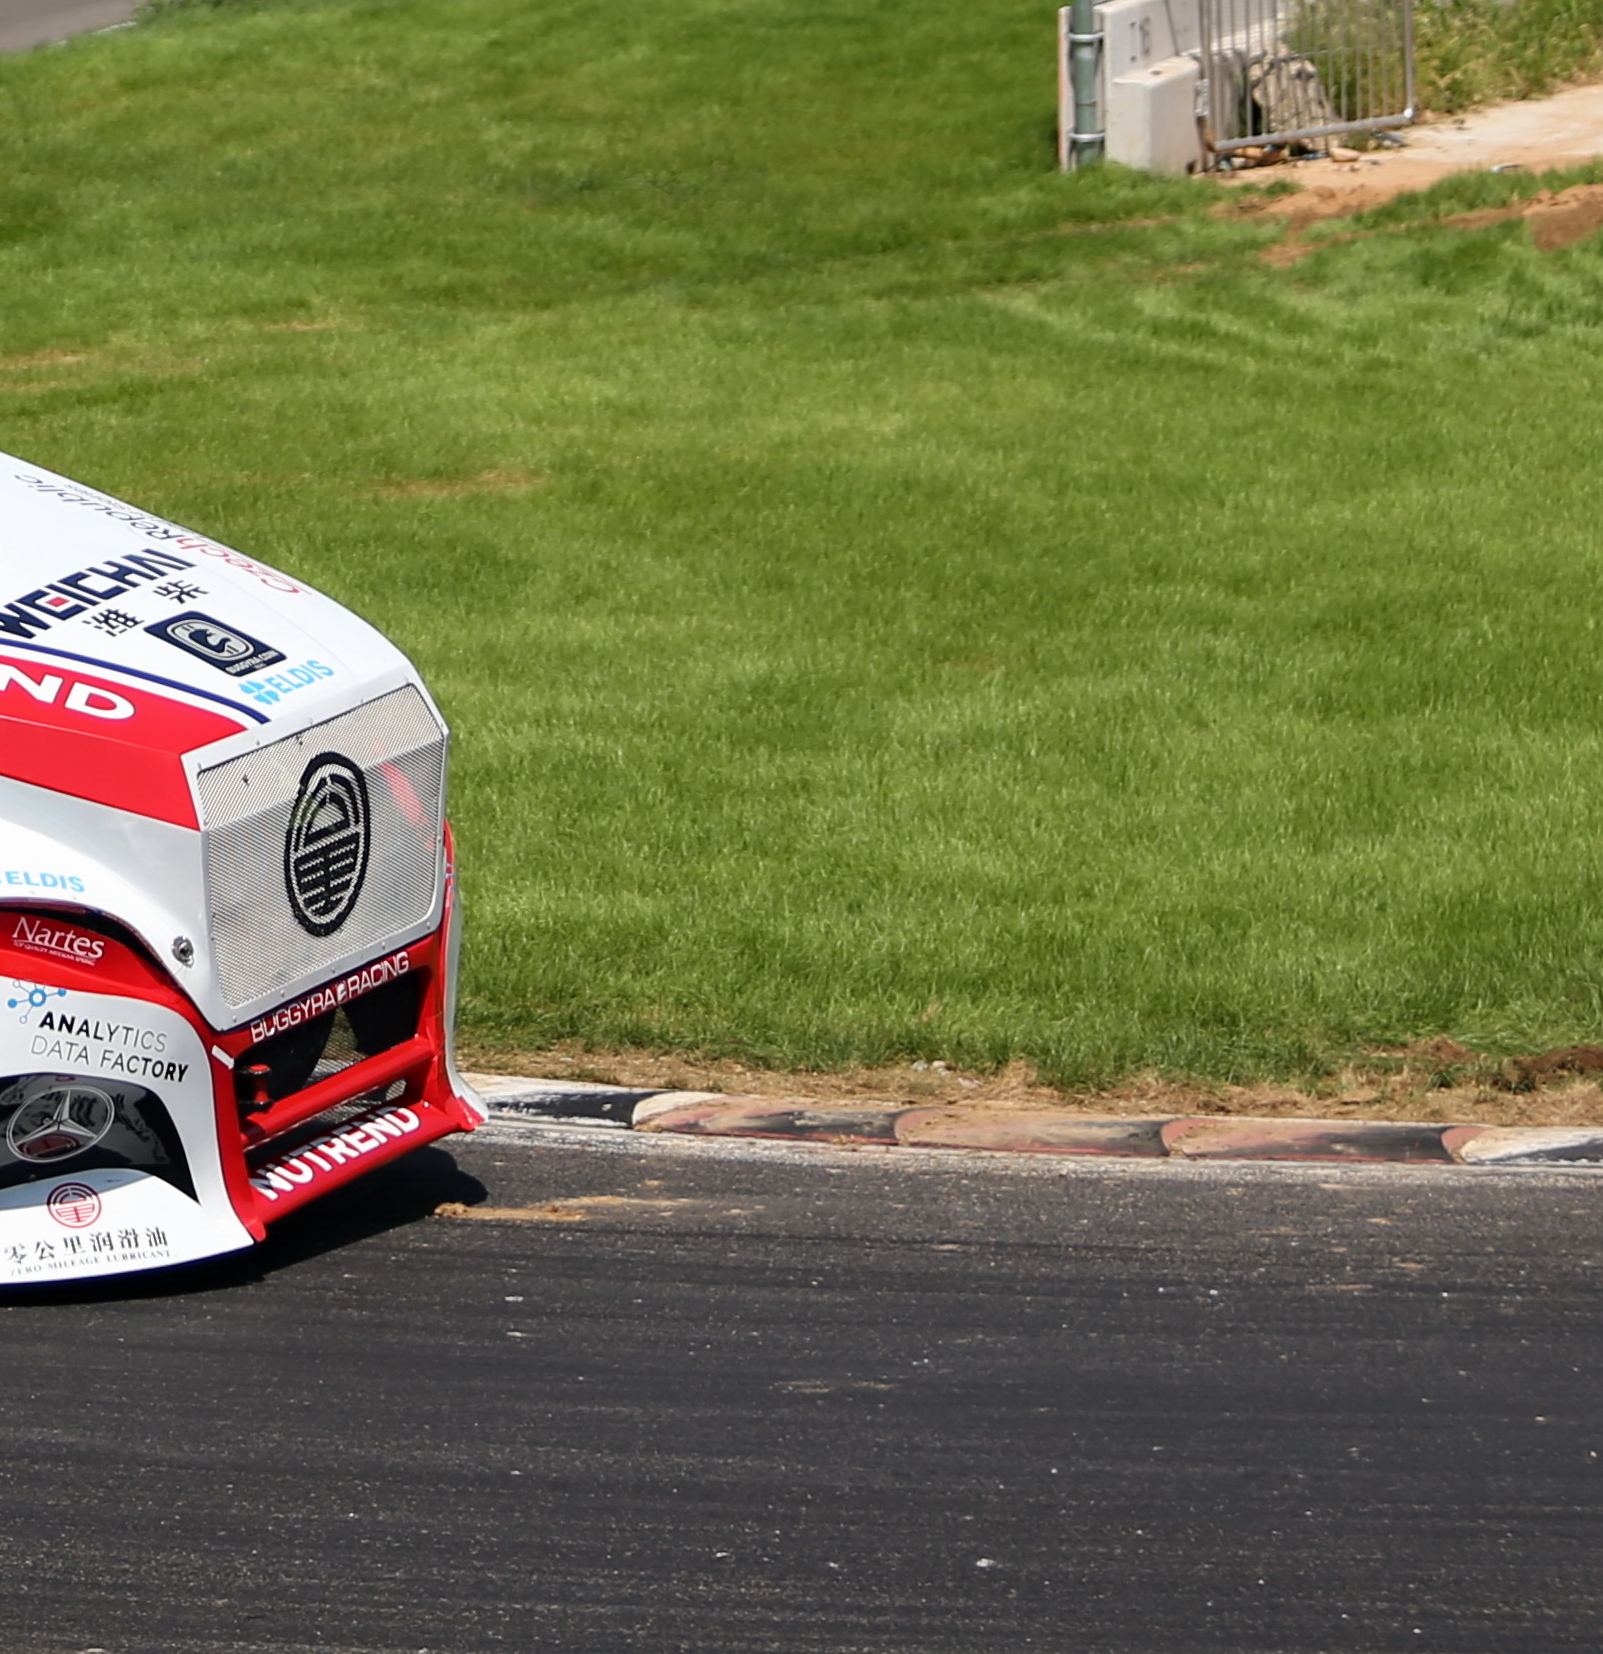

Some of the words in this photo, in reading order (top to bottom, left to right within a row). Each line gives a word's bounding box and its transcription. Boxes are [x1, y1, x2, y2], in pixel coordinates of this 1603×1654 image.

[263, 659, 335, 695] ELDIS
[5, 869, 86, 894] ELDIS
[11, 916, 106, 959] Nartes
[250, 987, 338, 1044] BUGGYRA
[345, 950, 411, 998] RACING
[39, 1011, 169, 1052] ANALYTICS
[30, 1035, 91, 1066] DATA
[99, 1049, 190, 1084] FACTORY
[250, 1104, 422, 1202] NUTREND
[3, 1226, 169, 1265] 零公里润滑油
[47, 1256, 102, 1271] MILEAGE
[106, 1249, 173, 1264] LUBRICANT
